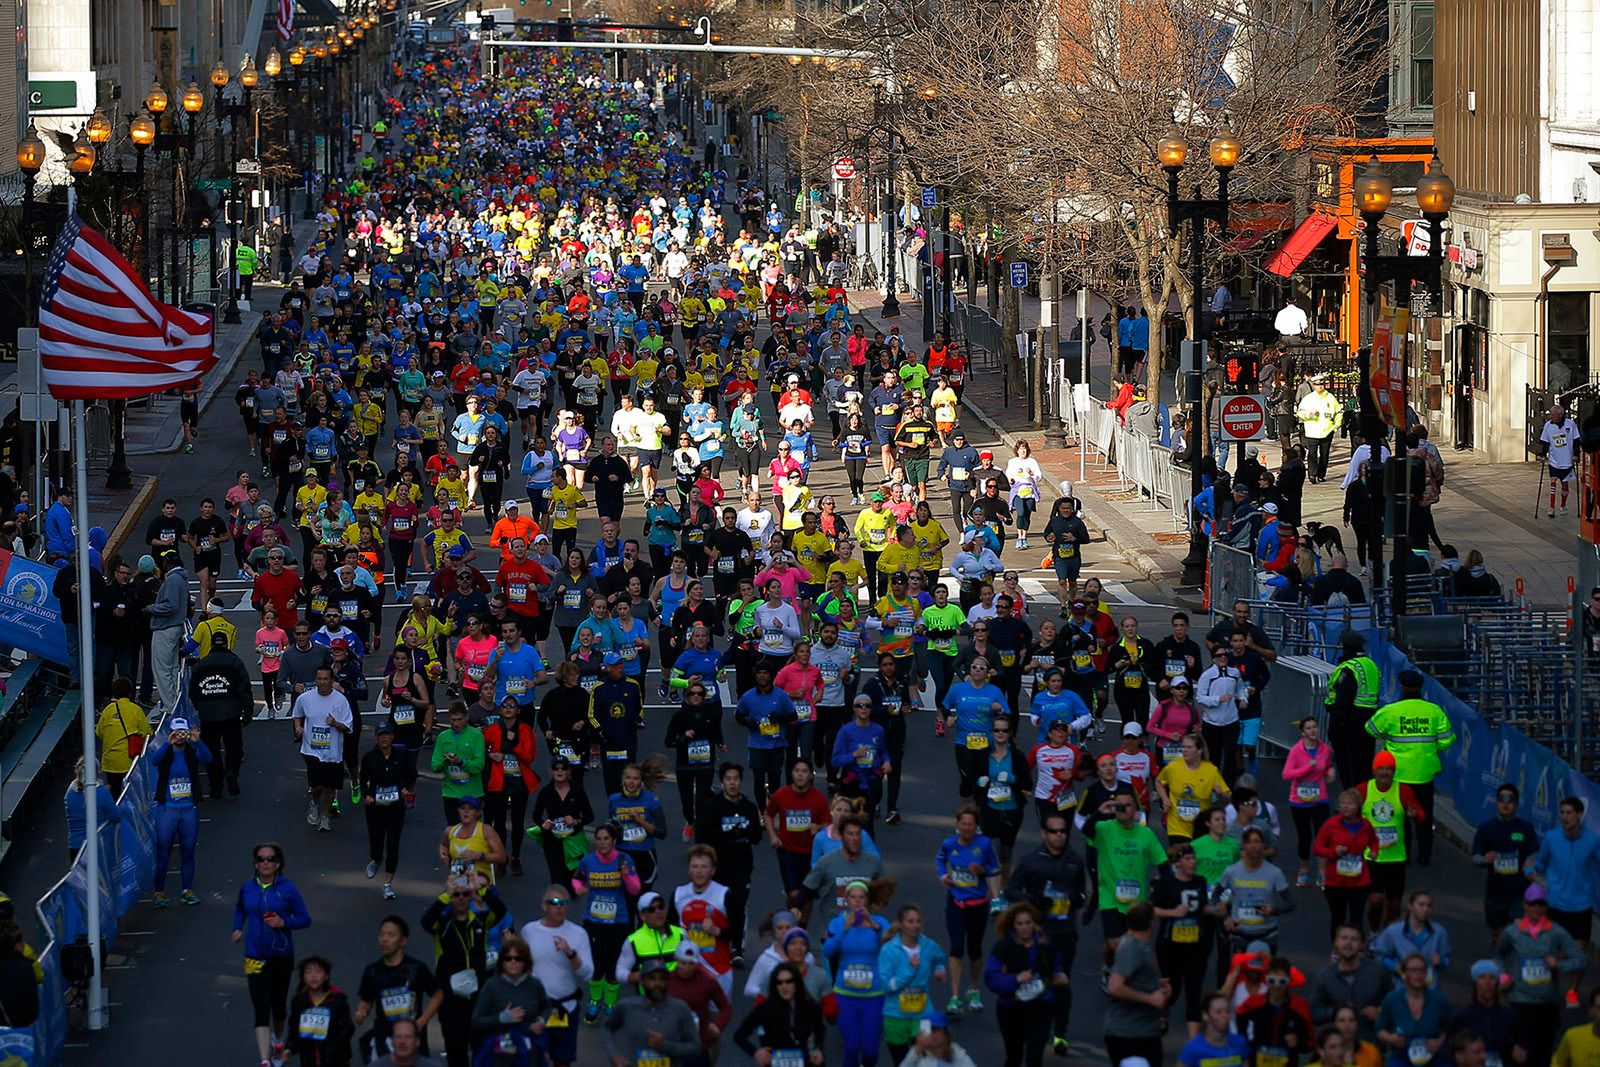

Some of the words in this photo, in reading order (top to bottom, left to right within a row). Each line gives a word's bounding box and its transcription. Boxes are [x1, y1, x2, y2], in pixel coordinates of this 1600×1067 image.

[1229, 404, 1239, 413] DO
[1241, 403, 1254, 412] NOT
[1232, 422, 1254, 431] ENTER
[15, 600, 57, 620] MARATHON
[198, 676, 214, 688] Boston
[215, 674, 230, 687] Police
[1400, 716, 1430, 725] Boston
[1400, 725, 1430, 734] Police
[1181, 891, 1199, 912] G
